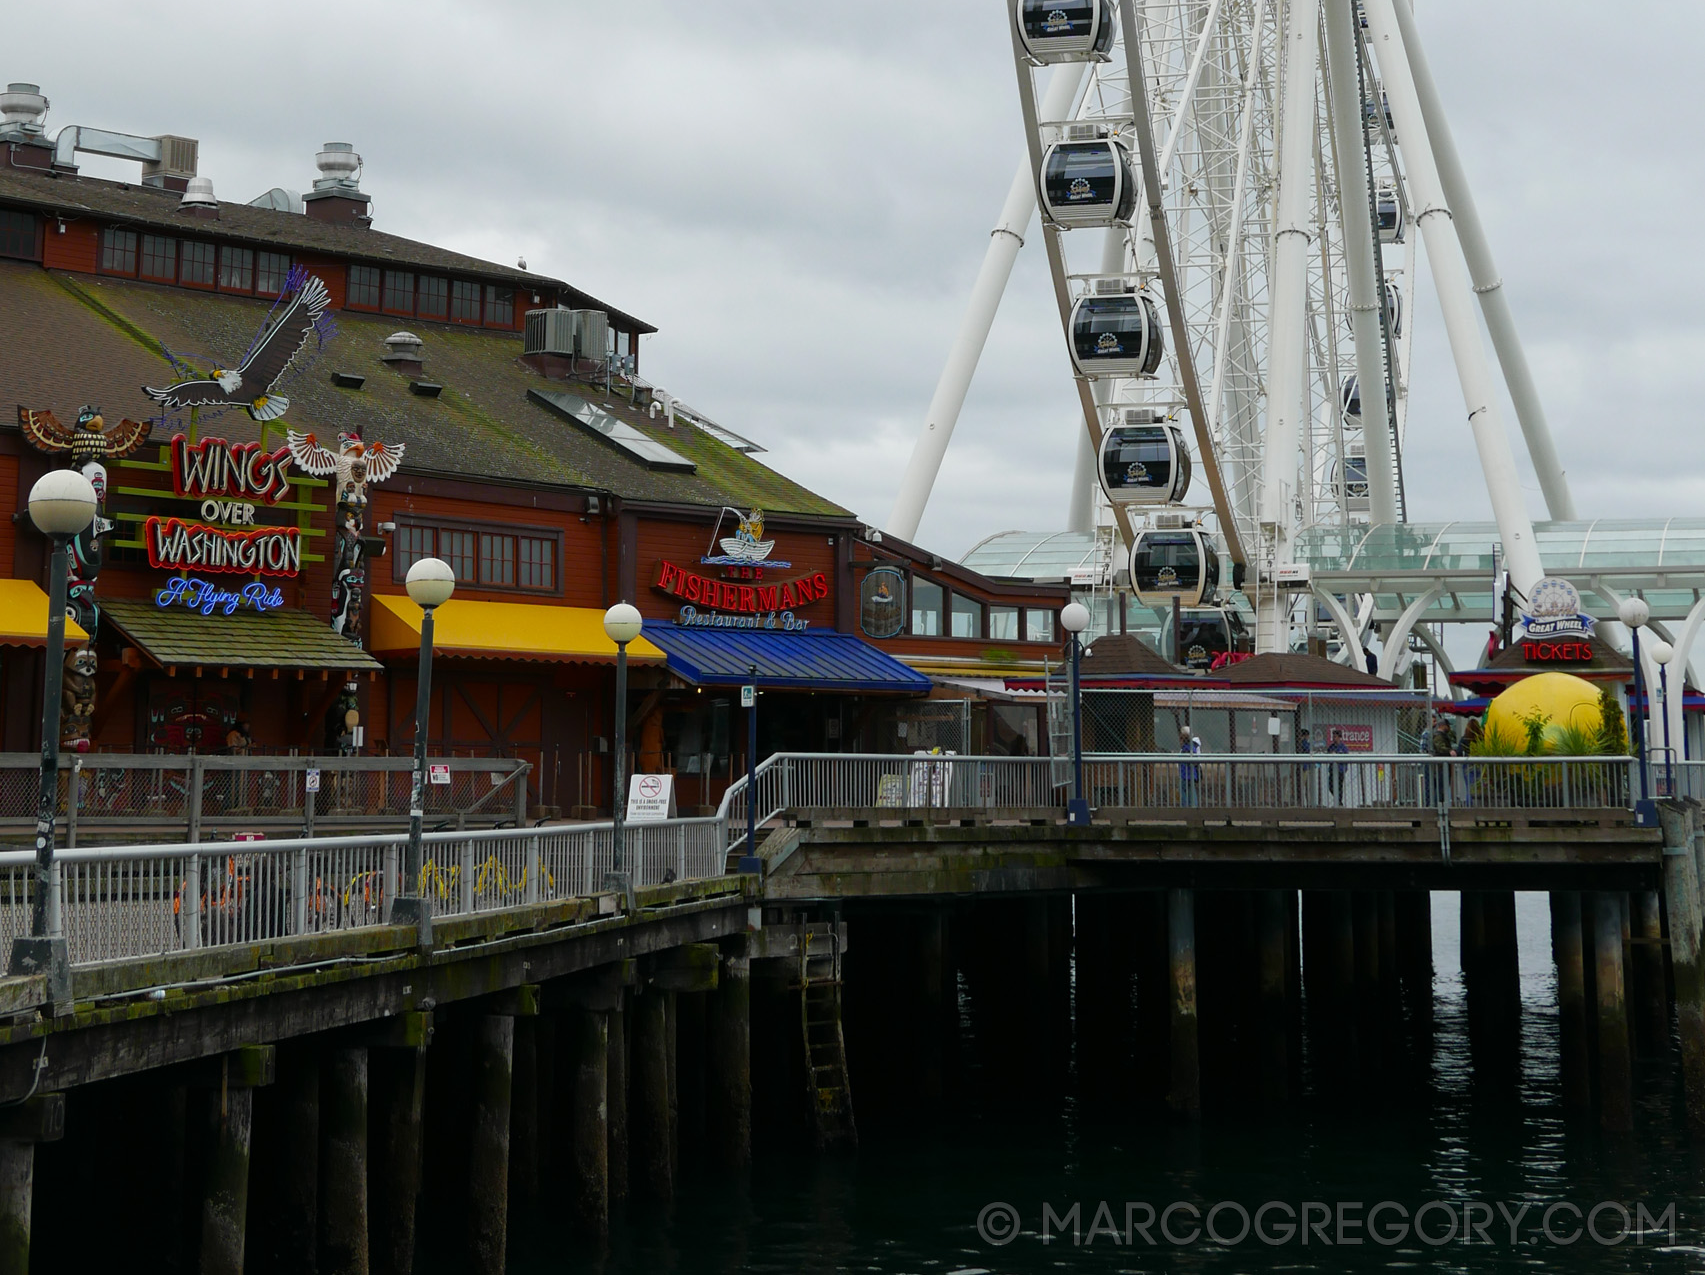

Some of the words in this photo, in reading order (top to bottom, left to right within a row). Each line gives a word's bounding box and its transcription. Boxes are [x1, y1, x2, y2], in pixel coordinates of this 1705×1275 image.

[174, 435, 293, 503] WINGS
[200, 499, 256, 525] OVER
[151, 521, 301, 574] WASHINGTON
[656, 559, 829, 613] FISHERMANS
[728, 566, 765, 580] THE
[156, 576, 187, 608] A
[187, 577, 241, 615] Flying
[242, 581, 284, 612] Ride
[680, 605, 761, 628] Restaurant
[764, 611, 776, 629] &
[780, 611, 810, 631] Bar
[1528, 622, 1556, 633] GREAT
[1556, 620, 1583, 630] WHEEL
[1521, 642, 1593, 660] TICKETS
